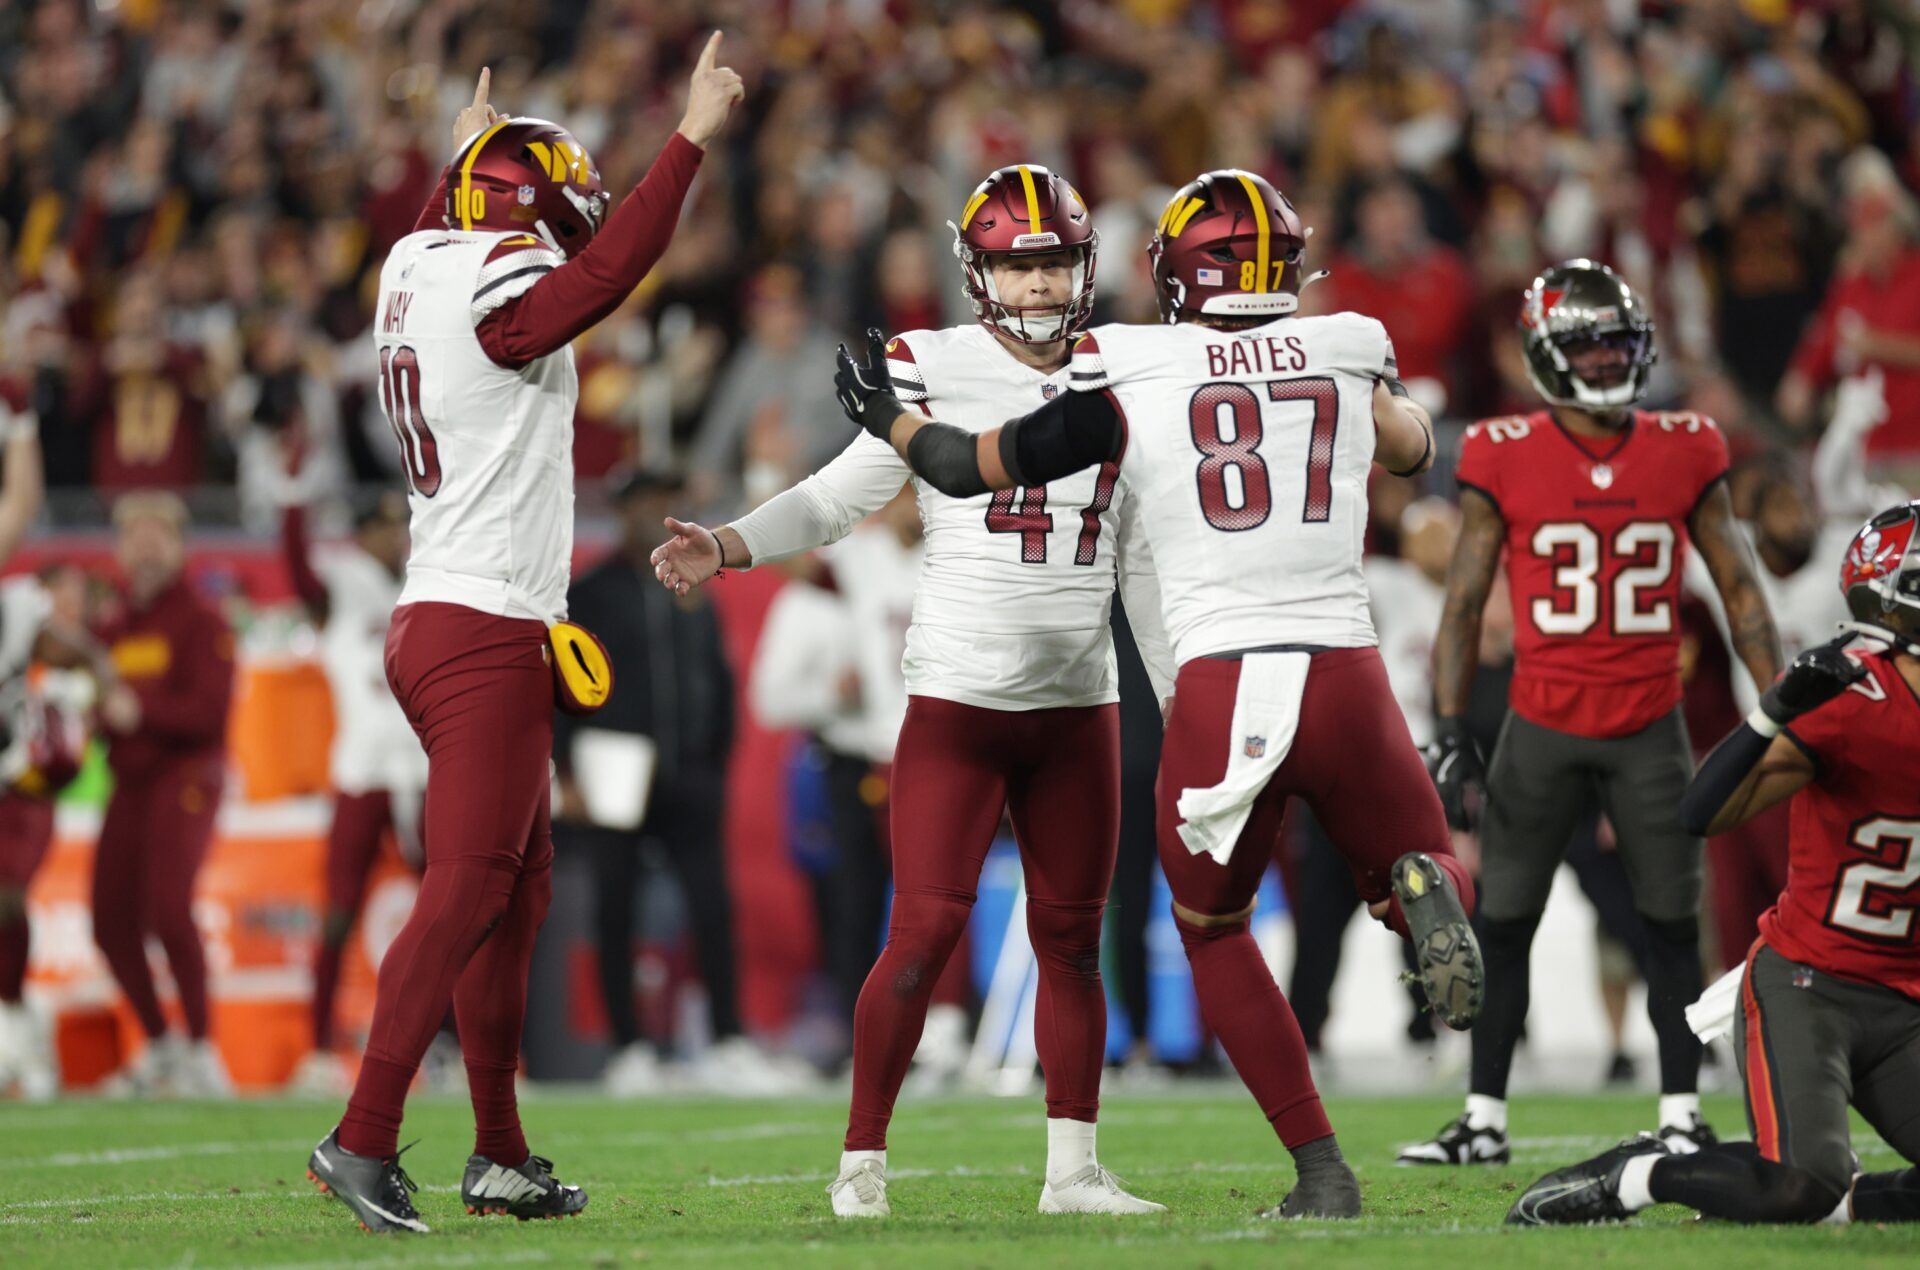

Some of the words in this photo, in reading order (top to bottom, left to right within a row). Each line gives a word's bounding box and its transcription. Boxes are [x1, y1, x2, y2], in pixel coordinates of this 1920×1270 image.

[454, 187, 485, 220] 10
[1019, 235, 1055, 245] COMMANDERS
[1240, 260, 1285, 291] 87
[384, 291, 414, 334] WAY
[1206, 336, 1307, 377] BATES
[379, 345, 442, 499] 10
[1188, 376, 1340, 532] 87
[1529, 520, 1677, 638] 32
